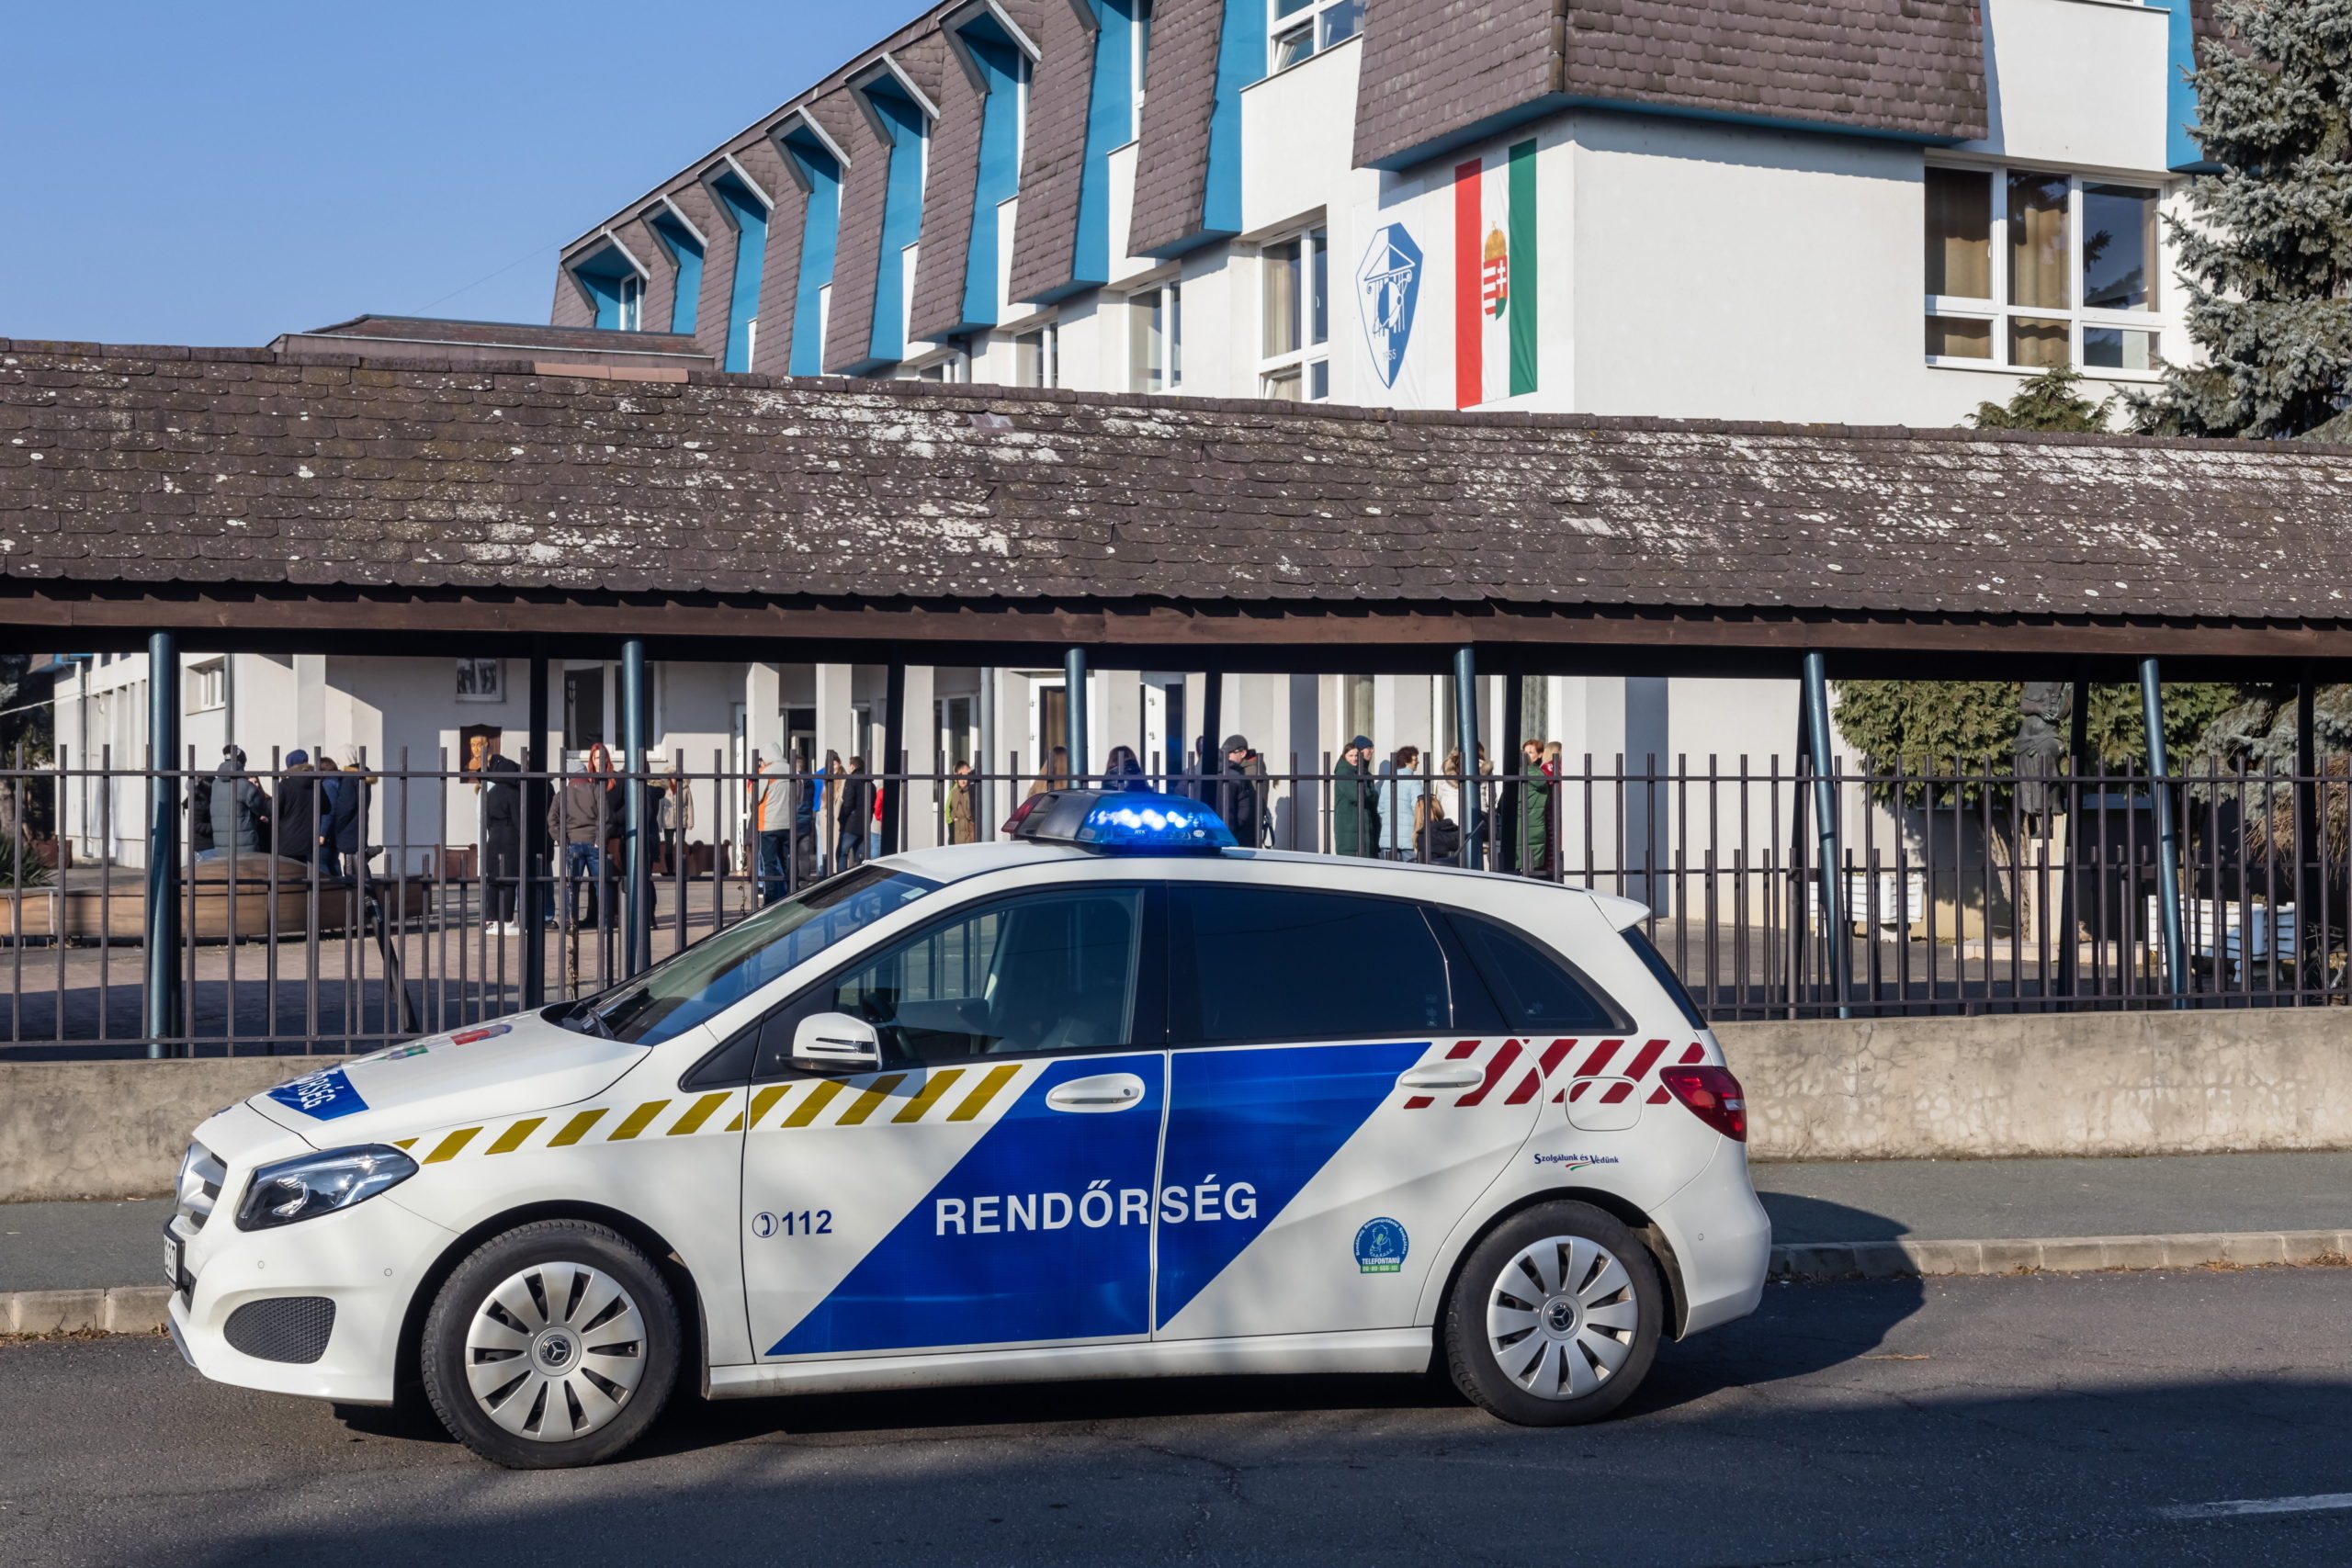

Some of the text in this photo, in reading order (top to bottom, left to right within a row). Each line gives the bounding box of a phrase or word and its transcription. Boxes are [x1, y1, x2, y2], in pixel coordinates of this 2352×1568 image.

[1533, 1153, 1578, 1165] Szolgálunk
[1589, 1155, 1619, 1164] Védünk
[936, 1174, 1258, 1235] RENDŐRSÉG
[782, 1210, 832, 1235] 112
[1362, 1256, 1400, 1265] TELEFONTANÚ
